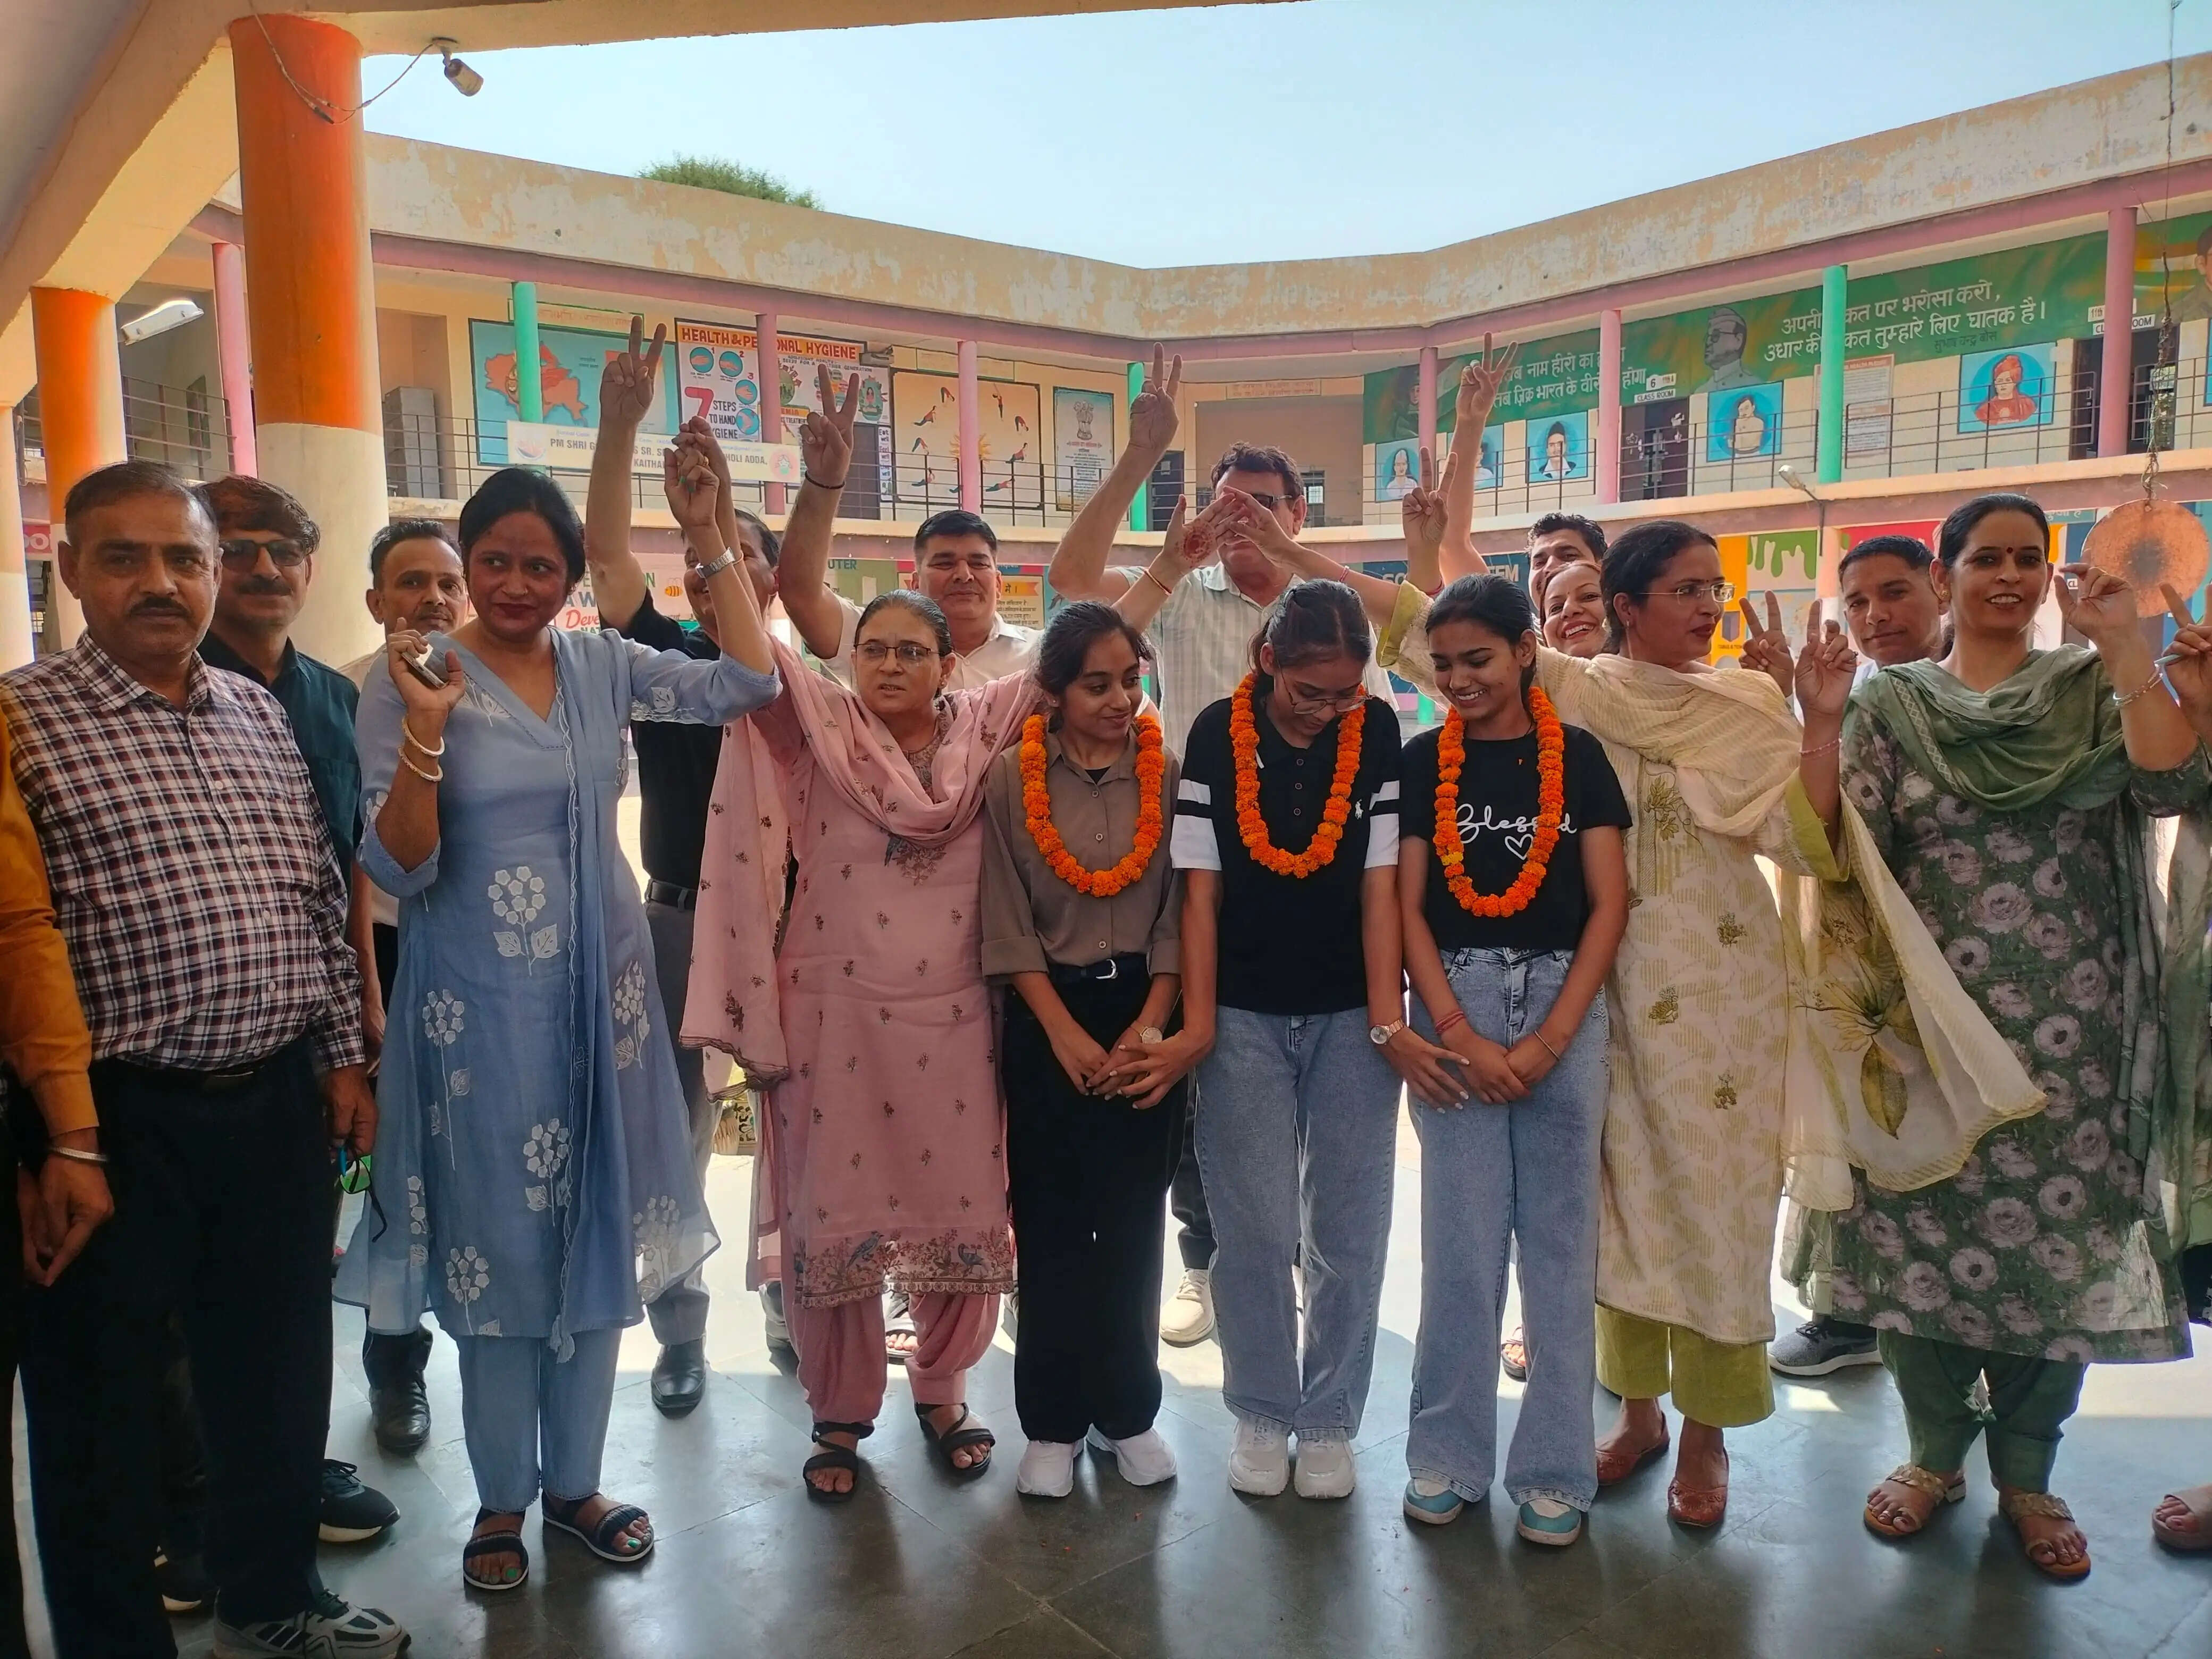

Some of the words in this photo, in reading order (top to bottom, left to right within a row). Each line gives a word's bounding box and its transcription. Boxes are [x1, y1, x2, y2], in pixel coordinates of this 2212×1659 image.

[1781, 308, 1822, 334] अपनी
[1875, 299, 1898, 317] पर
[1903, 287, 1954, 313] भरोसा
[2132, 316, 2151, 327] OOM
[1764, 340, 1804, 362] उधार
[1875, 317, 1924, 349] तुम्हारे
[1929, 313, 1961, 336] लिए
[1967, 305, 2015, 329] घातक
[682, 328, 730, 345] HEALTH
[806, 342, 856, 359] HYGIENE
[1527, 361, 1549, 378] नाम
[1552, 352, 1576, 378] हीरो
[1579, 353, 1594, 368] का
[1536, 382, 1565, 399] भारत
[1566, 376, 1578, 395] के
[1622, 366, 1647, 390] होगा
[1650, 379, 1656, 388] 6
[1637, 392, 1655, 402] CLASS
[1656, 390, 1674, 399] ROOM
[684, 387, 714, 419] 7
[713, 400, 736, 412] STEPS
[709, 414, 718, 423] TO
[719, 415, 736, 425] HAND
[550, 438, 564, 447] PM
[567, 440, 586, 450] SHRI
[641, 447, 655, 456] SR.
